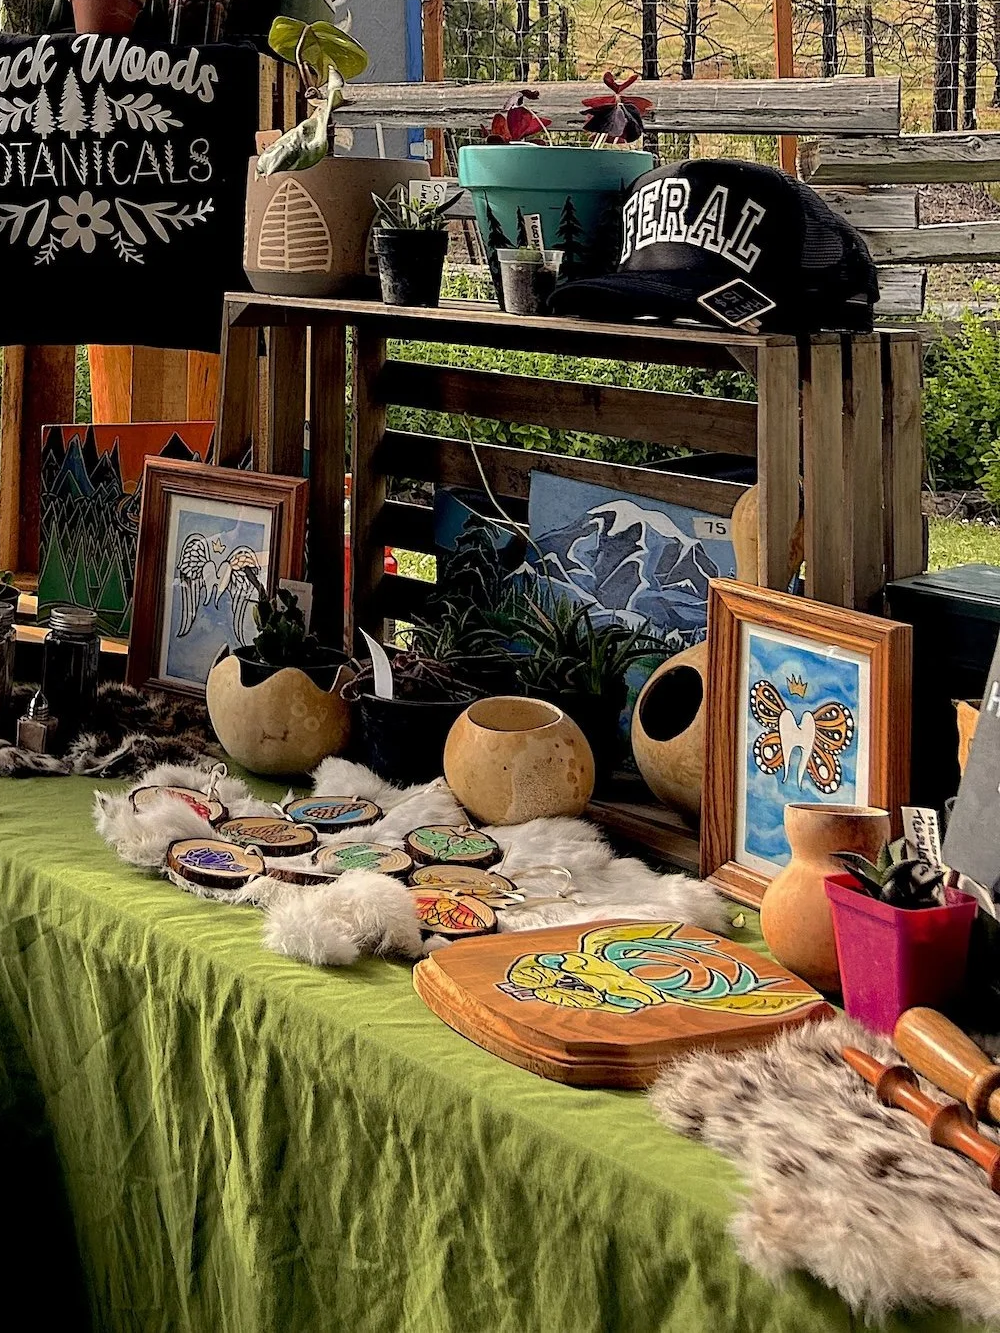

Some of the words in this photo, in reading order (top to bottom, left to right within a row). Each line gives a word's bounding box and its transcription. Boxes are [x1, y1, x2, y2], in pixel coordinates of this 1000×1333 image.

[71, 34, 219, 103] Woods
[619, 177, 767, 274] FERAL
[725, 298, 765, 320] HATS
[704, 521, 727, 535] 75
